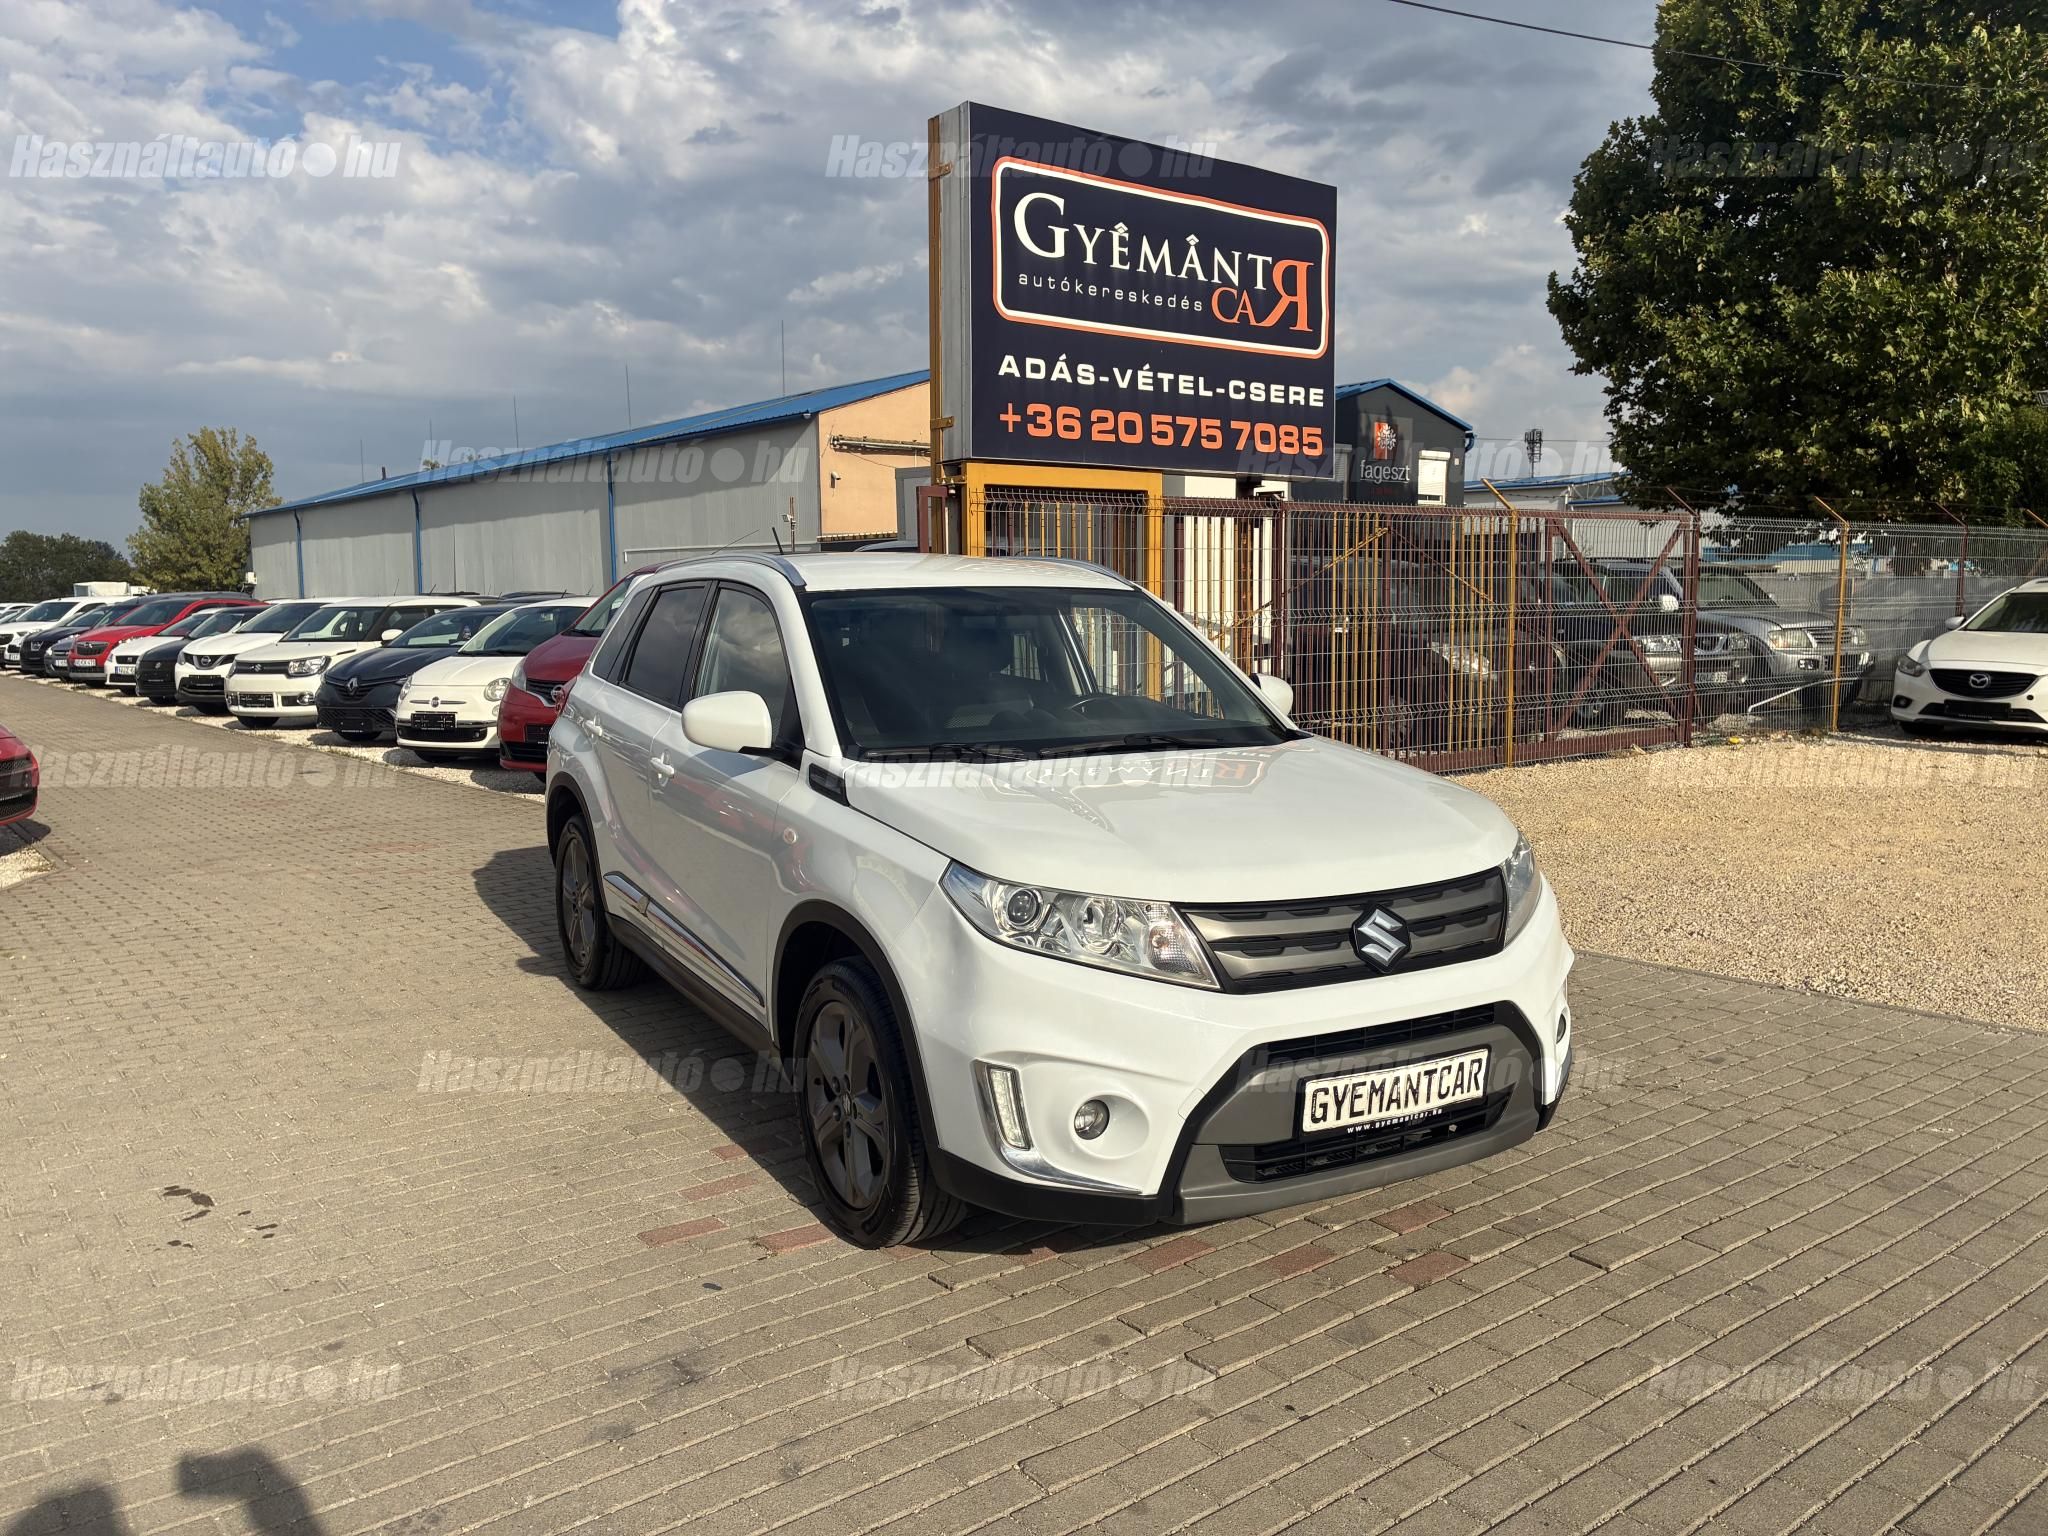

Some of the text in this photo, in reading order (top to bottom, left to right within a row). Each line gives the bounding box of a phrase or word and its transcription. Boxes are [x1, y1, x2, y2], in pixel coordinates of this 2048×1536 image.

[1018, 273, 1203, 312] autókereskedés
[999, 402, 1323, 456] +36 20 575 7085
[1360, 460, 1411, 485] fageszt
[1310, 1057, 1484, 1124] GYEMANTCAR
